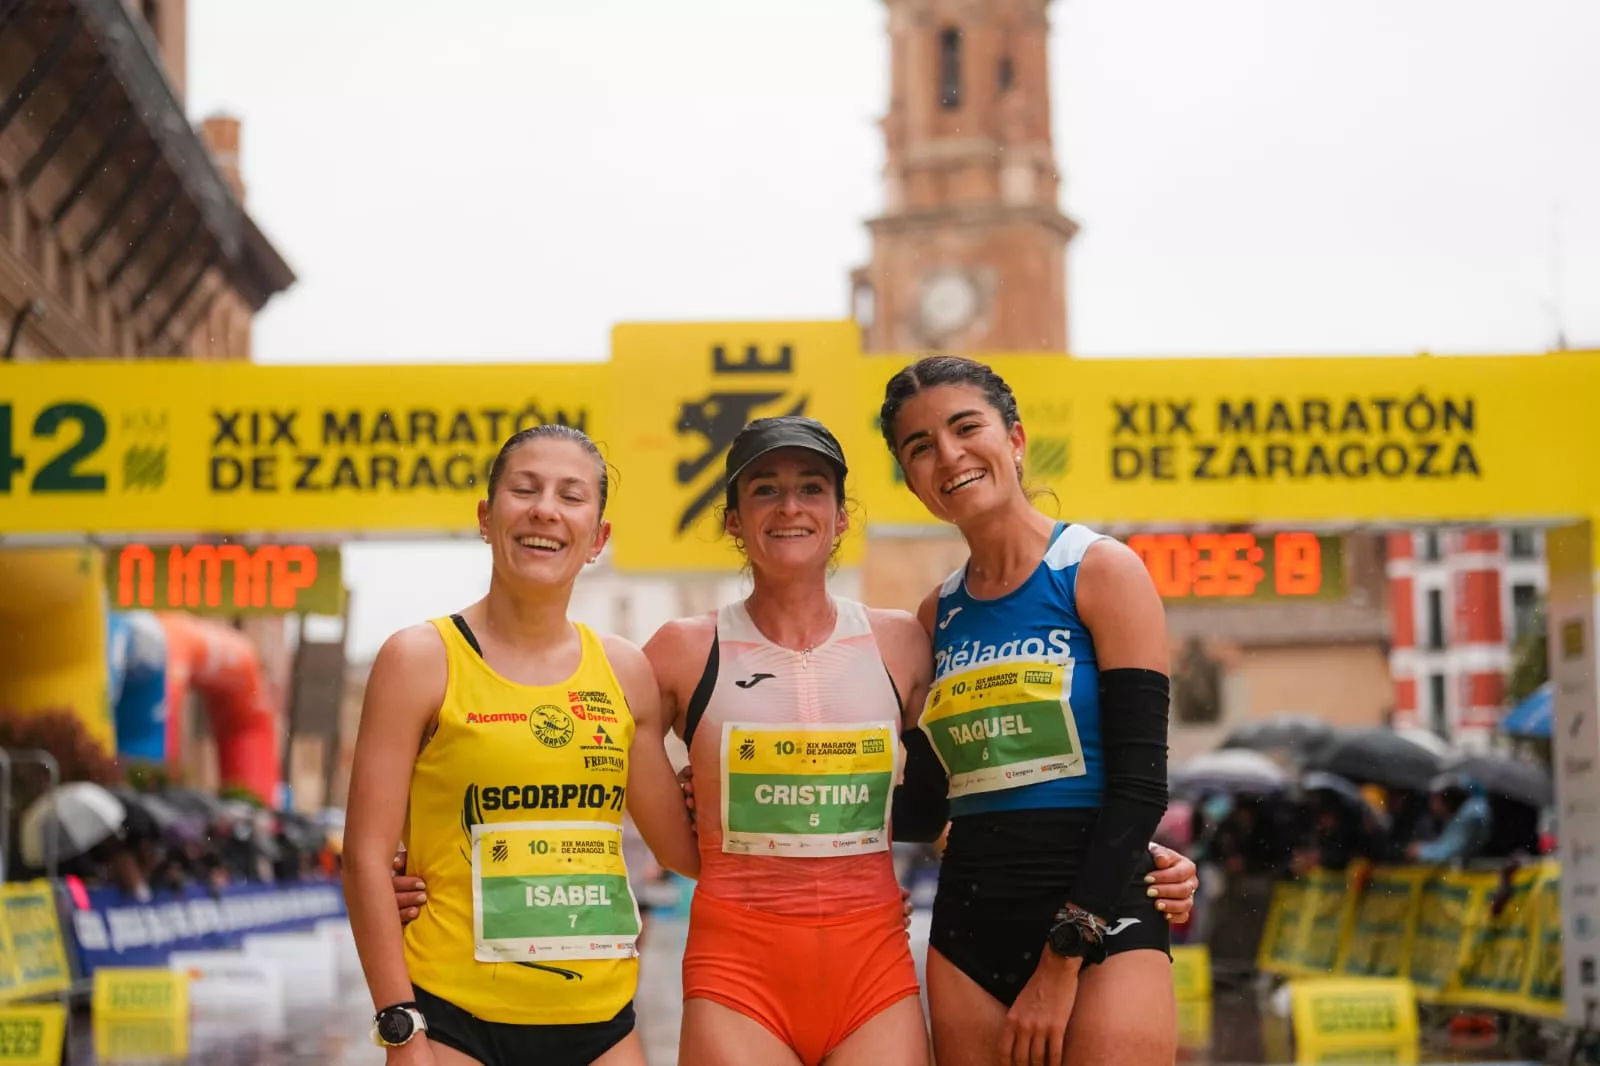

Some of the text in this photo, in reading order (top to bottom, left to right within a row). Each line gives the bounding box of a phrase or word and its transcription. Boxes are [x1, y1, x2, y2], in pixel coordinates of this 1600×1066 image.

[1111, 402, 1196, 435] XIX
[1218, 391, 1475, 435] MARATÓN
[213, 411, 296, 445] XIX
[1111, 443, 1480, 480] DE ZARAGOZA
[211, 456, 277, 491] DE
[951, 682, 966, 696] 10
[466, 712, 528, 724] Alcampo
[949, 715, 1032, 745] RAQUEL
[775, 741, 795, 755] 10
[982, 747, 988, 761] 6
[754, 784, 870, 805] CRISTINA
[809, 813, 820, 827] 5
[528, 840, 548, 855] 10
[525, 885, 611, 907] ISABEL
[568, 914, 578, 928] 7
